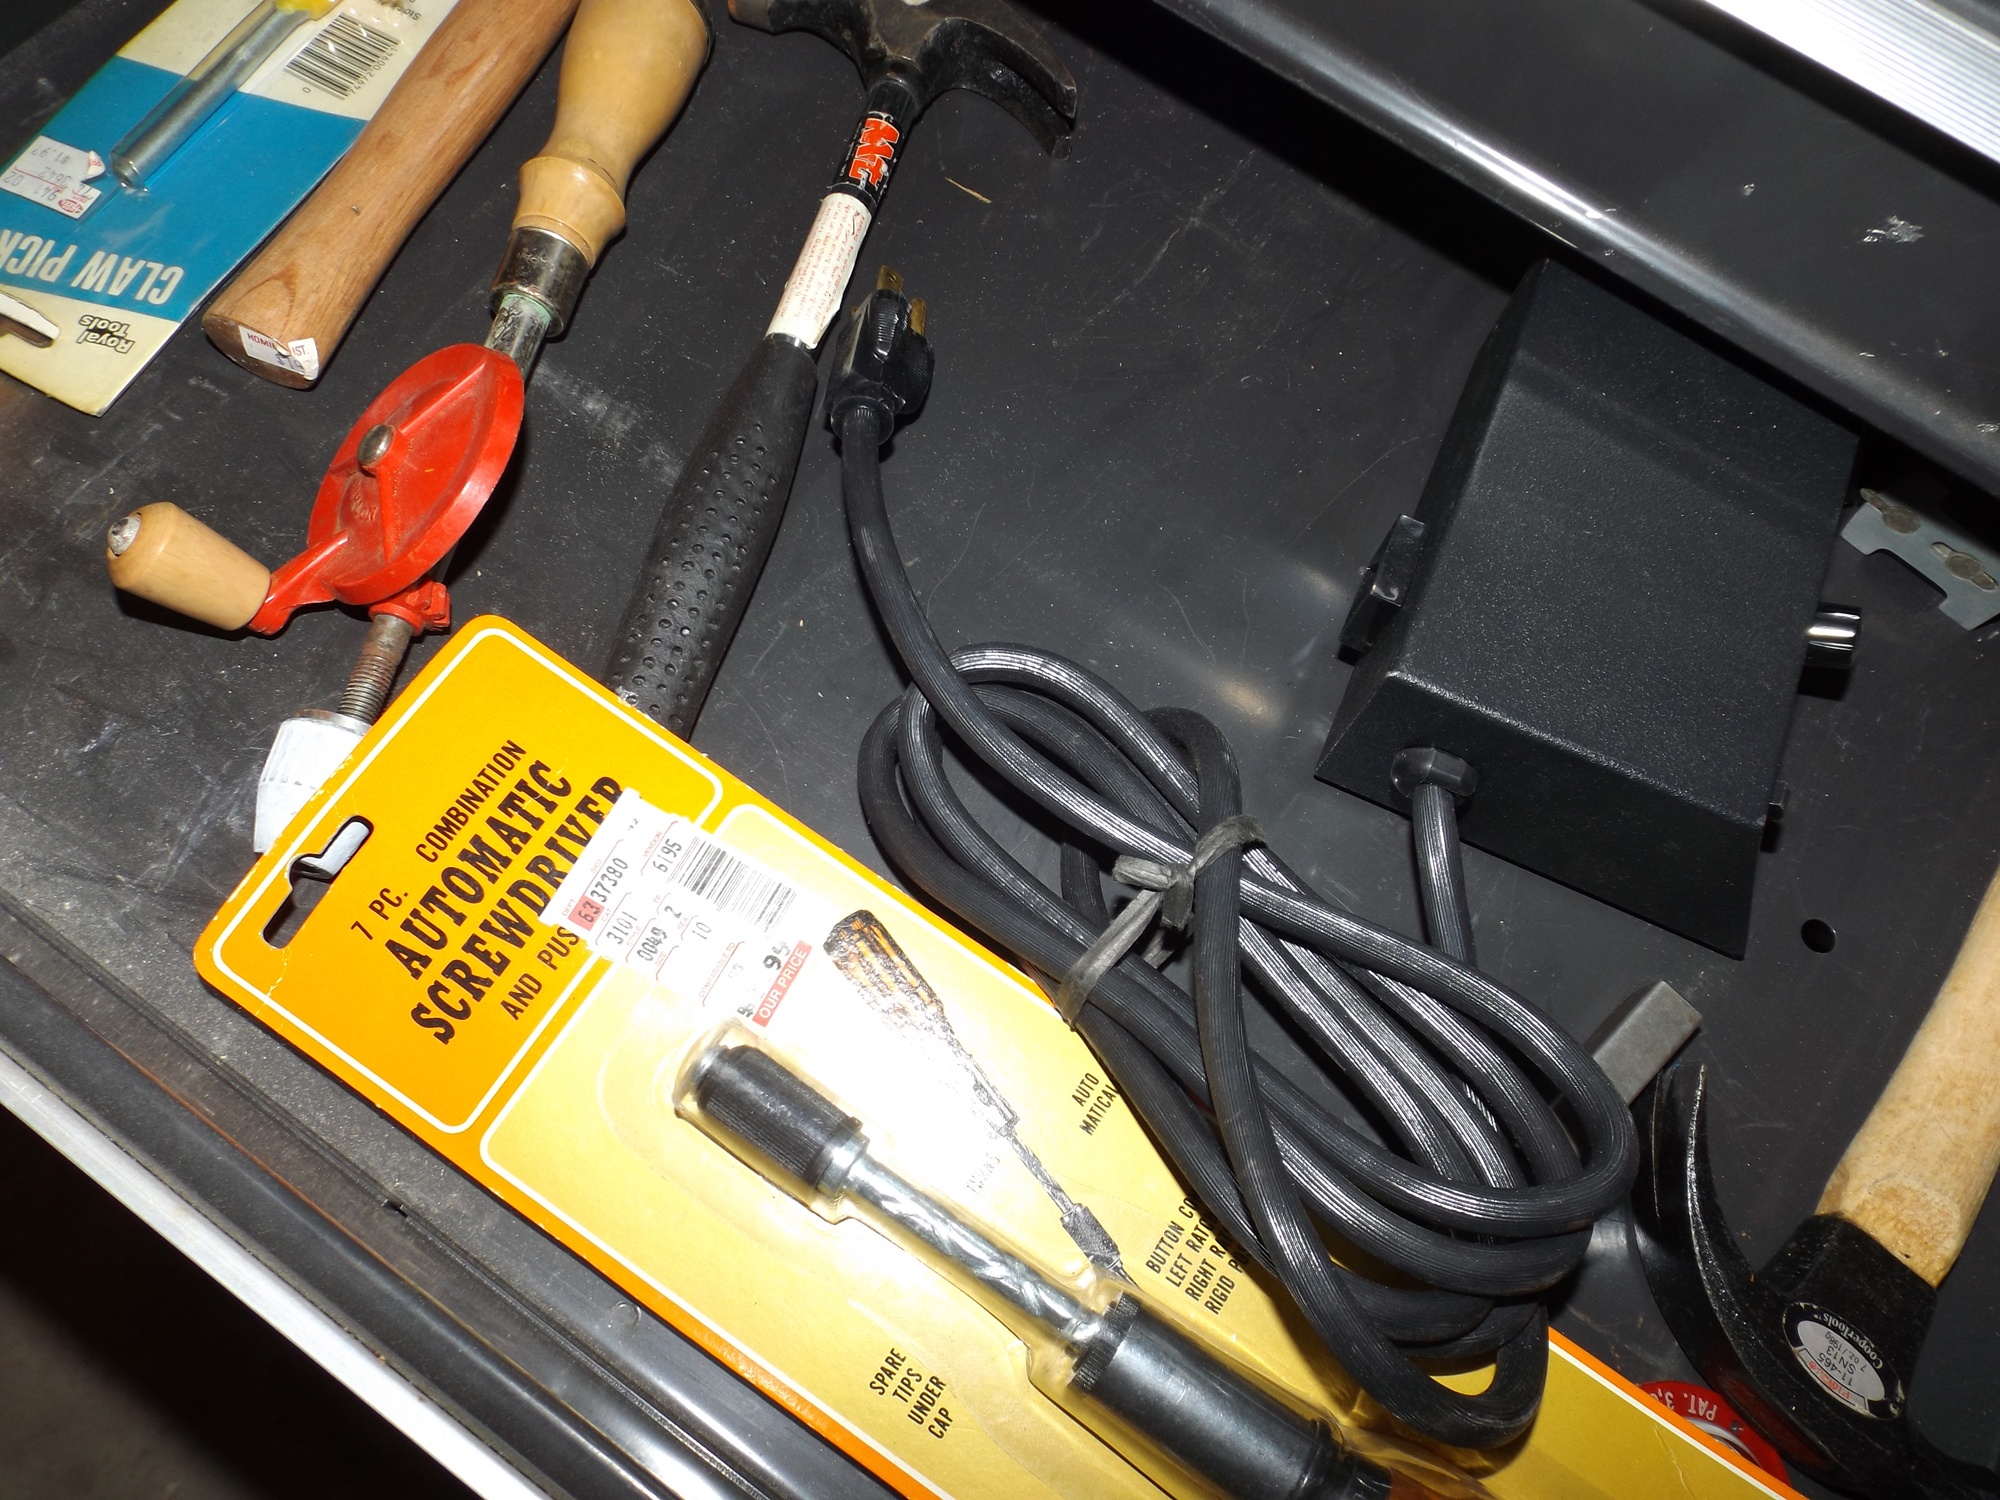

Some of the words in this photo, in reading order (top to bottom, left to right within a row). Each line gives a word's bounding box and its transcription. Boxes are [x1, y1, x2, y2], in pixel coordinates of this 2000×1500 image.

[302, 86, 311, 94] 0
[348, 72, 375, 95] 74972
[4, 170, 24, 187] 02
[70, 250, 185, 305] CLAW
[76, 328, 135, 354] Royal
[79, 314, 131, 338] Tools
[292, 345, 310, 356] IST.
[351, 920, 373, 940] 7
[368, 888, 409, 921] PC.
[415, 739, 527, 863] COMBINATION
[643, 831, 663, 858] VENDOR
[653, 838, 682, 872] 6195
[385, 759, 572, 980] AUTOMATIC
[591, 860, 602, 874] SKU
[578, 901, 601, 922] 63
[590, 858, 628, 902] 37380
[410, 776, 624, 1045] SCREWDRIVER
[602, 908, 613, 922] CAT
[606, 911, 637, 944] 3101
[664, 905, 682, 918] 2
[692, 922, 712, 940] 10
[500, 972, 543, 1021] AND
[537, 926, 581, 971] PUS
[759, 989, 782, 1019] OUR
[777, 949, 807, 988] PRICE
[1071, 1072, 1100, 1107] AUTO
[1079, 1084, 1120, 1136] MATICAL
[1145, 1221, 1185, 1274] BUTTON
[1166, 1253, 1194, 1288] LEFT
[1185, 1259, 1217, 1301] RIGHT
[1204, 1274, 1235, 1315] RIGID
[869, 1347, 907, 1396] SPARE
[1819, 1352, 1853, 1386] 11-465
[1826, 1345, 1856, 1375] SN13
[1860, 1364, 1867, 1373] 7
[892, 1367, 923, 1403] TIPS
[907, 1375, 947, 1425] UNDER
[928, 1407, 953, 1439] CAP
[1683, 1392, 1718, 1421] PAT.
